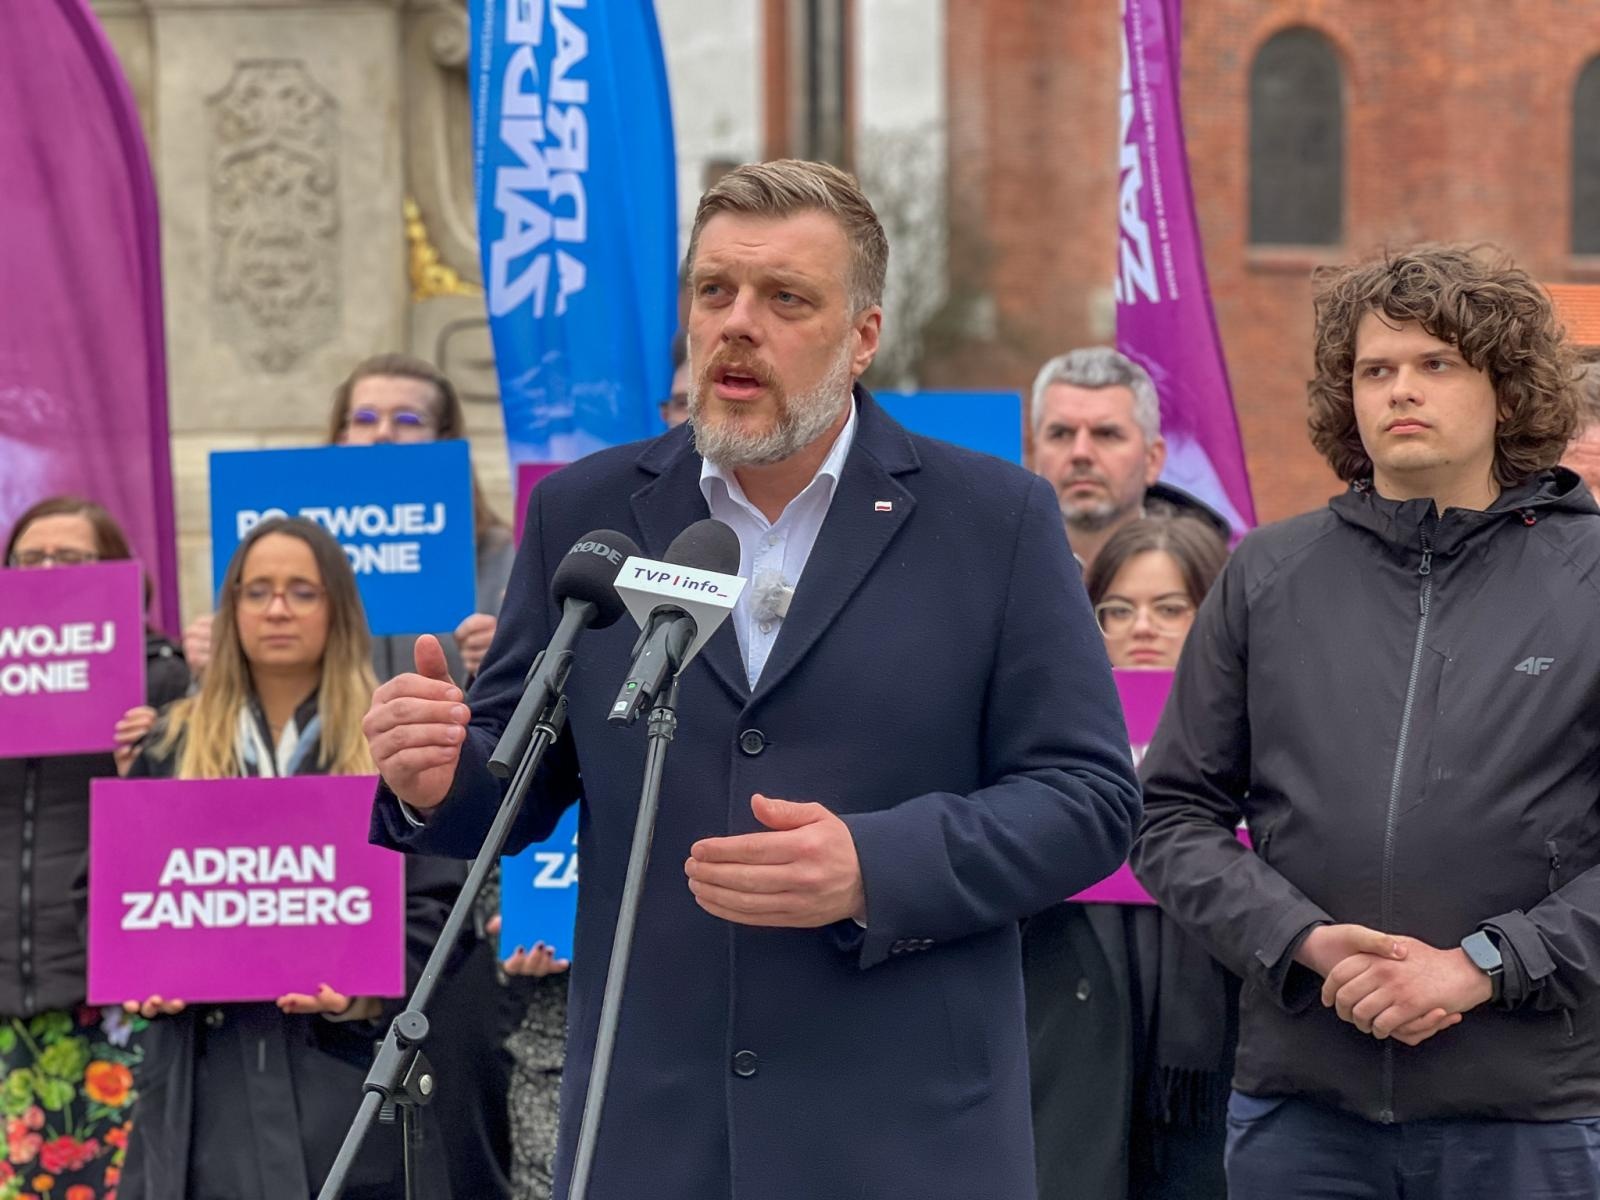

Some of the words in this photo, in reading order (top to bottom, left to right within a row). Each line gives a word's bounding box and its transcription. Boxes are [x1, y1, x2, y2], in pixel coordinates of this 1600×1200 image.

[633, 567, 670, 583] TVP
[1513, 656, 1554, 675] 4F
[159, 844, 336, 886] ADRIAN
[120, 886, 372, 931] ZANDBERG
